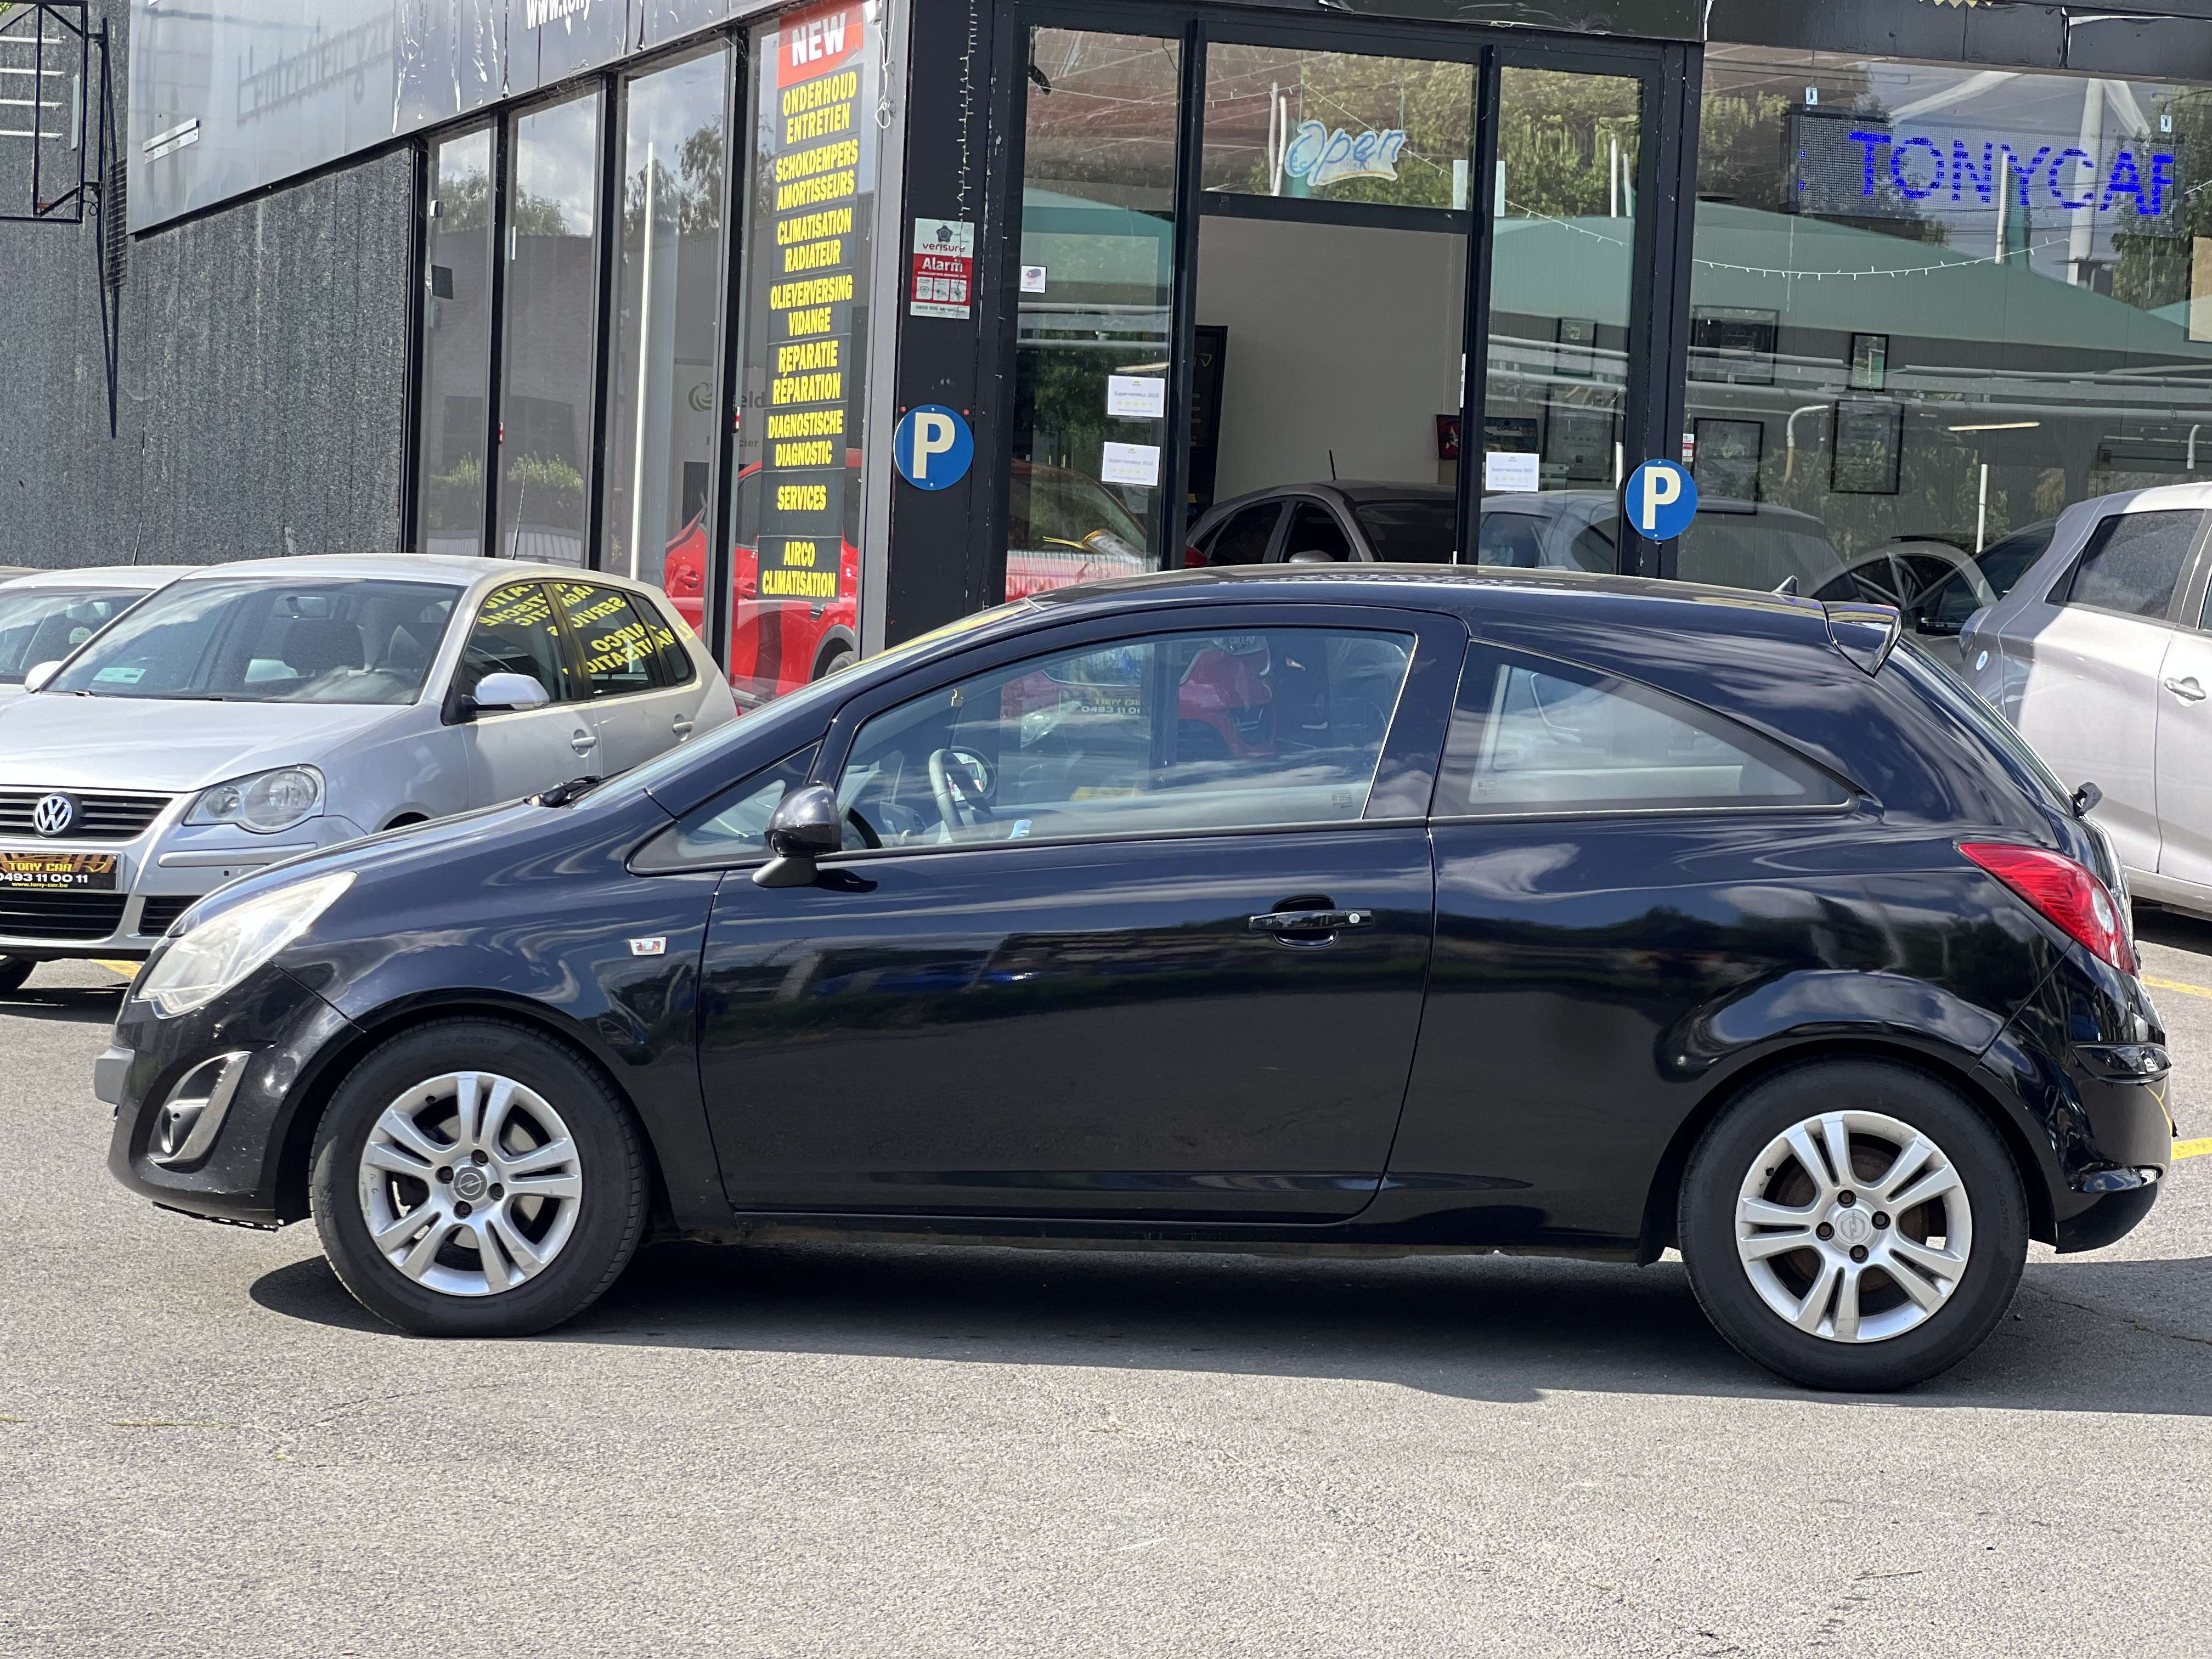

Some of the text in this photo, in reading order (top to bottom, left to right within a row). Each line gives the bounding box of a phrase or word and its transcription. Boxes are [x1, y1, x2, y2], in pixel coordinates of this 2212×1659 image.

[792, 13, 846, 66] NEW
[783, 71, 857, 117] ONDERHOUD
[787, 102, 850, 144] ENTRETIEN
[775, 139, 859, 183] SCHOKDEMPERS
[1289, 123, 1404, 183] Open
[777, 170, 854, 211] AMORTISSEURS
[777, 208, 852, 246] CLIMATISATION
[785, 239, 841, 273] RADIATEUR
[923, 242, 966, 252] verisure
[922, 257, 963, 272] Alarm
[770, 274, 853, 311] OLIEVERVERSING
[788, 307, 831, 336] VIDANGE
[778, 340, 839, 373] REPARATIE
[772, 371, 841, 404] RÉPARATION
[768, 410, 843, 439] DIAGNOSTISCHE
[775, 441, 832, 467] DIAGNOSTIC
[913, 413, 955, 478] P
[777, 485, 827, 511] SERVICES
[1643, 467, 1681, 529] P
[783, 541, 816, 567] AIRCO
[763, 571, 836, 597] CLIMATISATION
[9, 862, 72, 872] TONY CAR
[36, 873, 47, 882] 11
[50, 874, 73, 883] 00
[76, 874, 88, 883] 11
